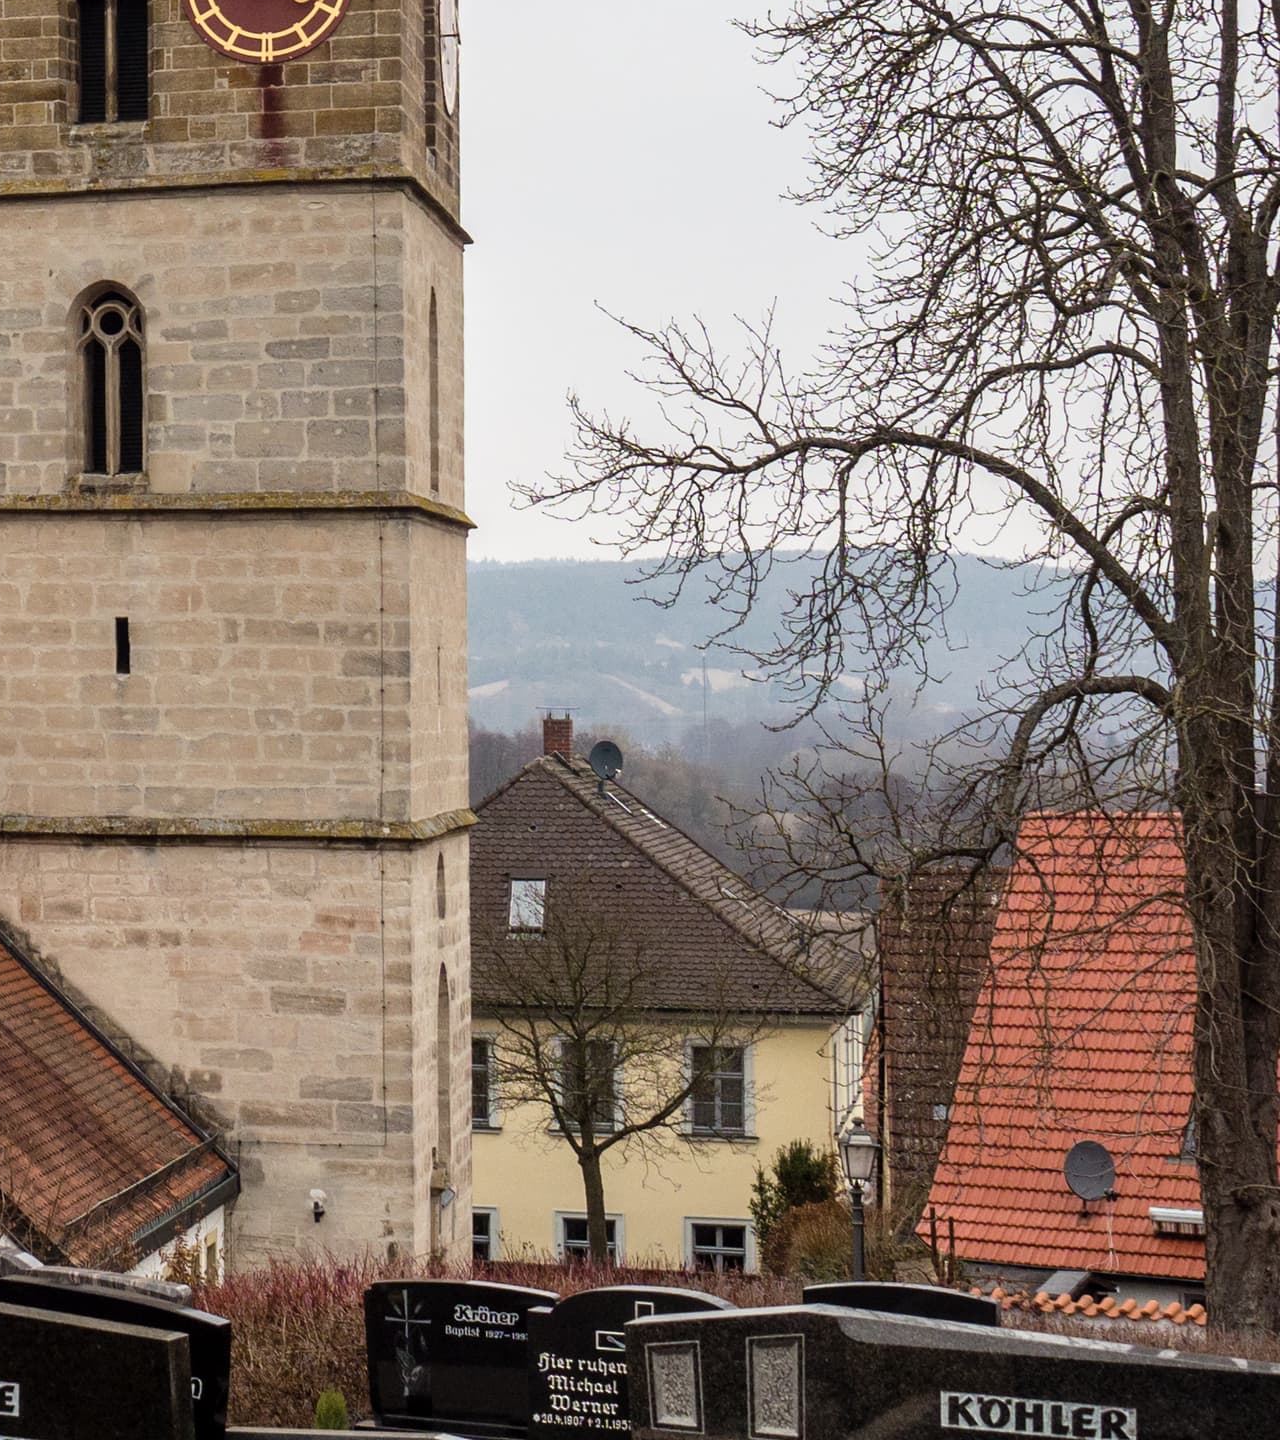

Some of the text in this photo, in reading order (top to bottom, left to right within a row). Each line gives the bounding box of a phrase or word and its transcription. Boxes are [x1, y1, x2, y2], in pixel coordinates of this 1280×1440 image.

[453, 1303, 520, 1326] Kröner
[445, 1324, 480, 1338] Baptist
[537, 1352, 628, 1377] Hier ruhen
[547, 1374, 619, 1396] Michael
[549, 1394, 619, 1415] Werner
[947, 1394, 1131, 1440] KÖHLER
